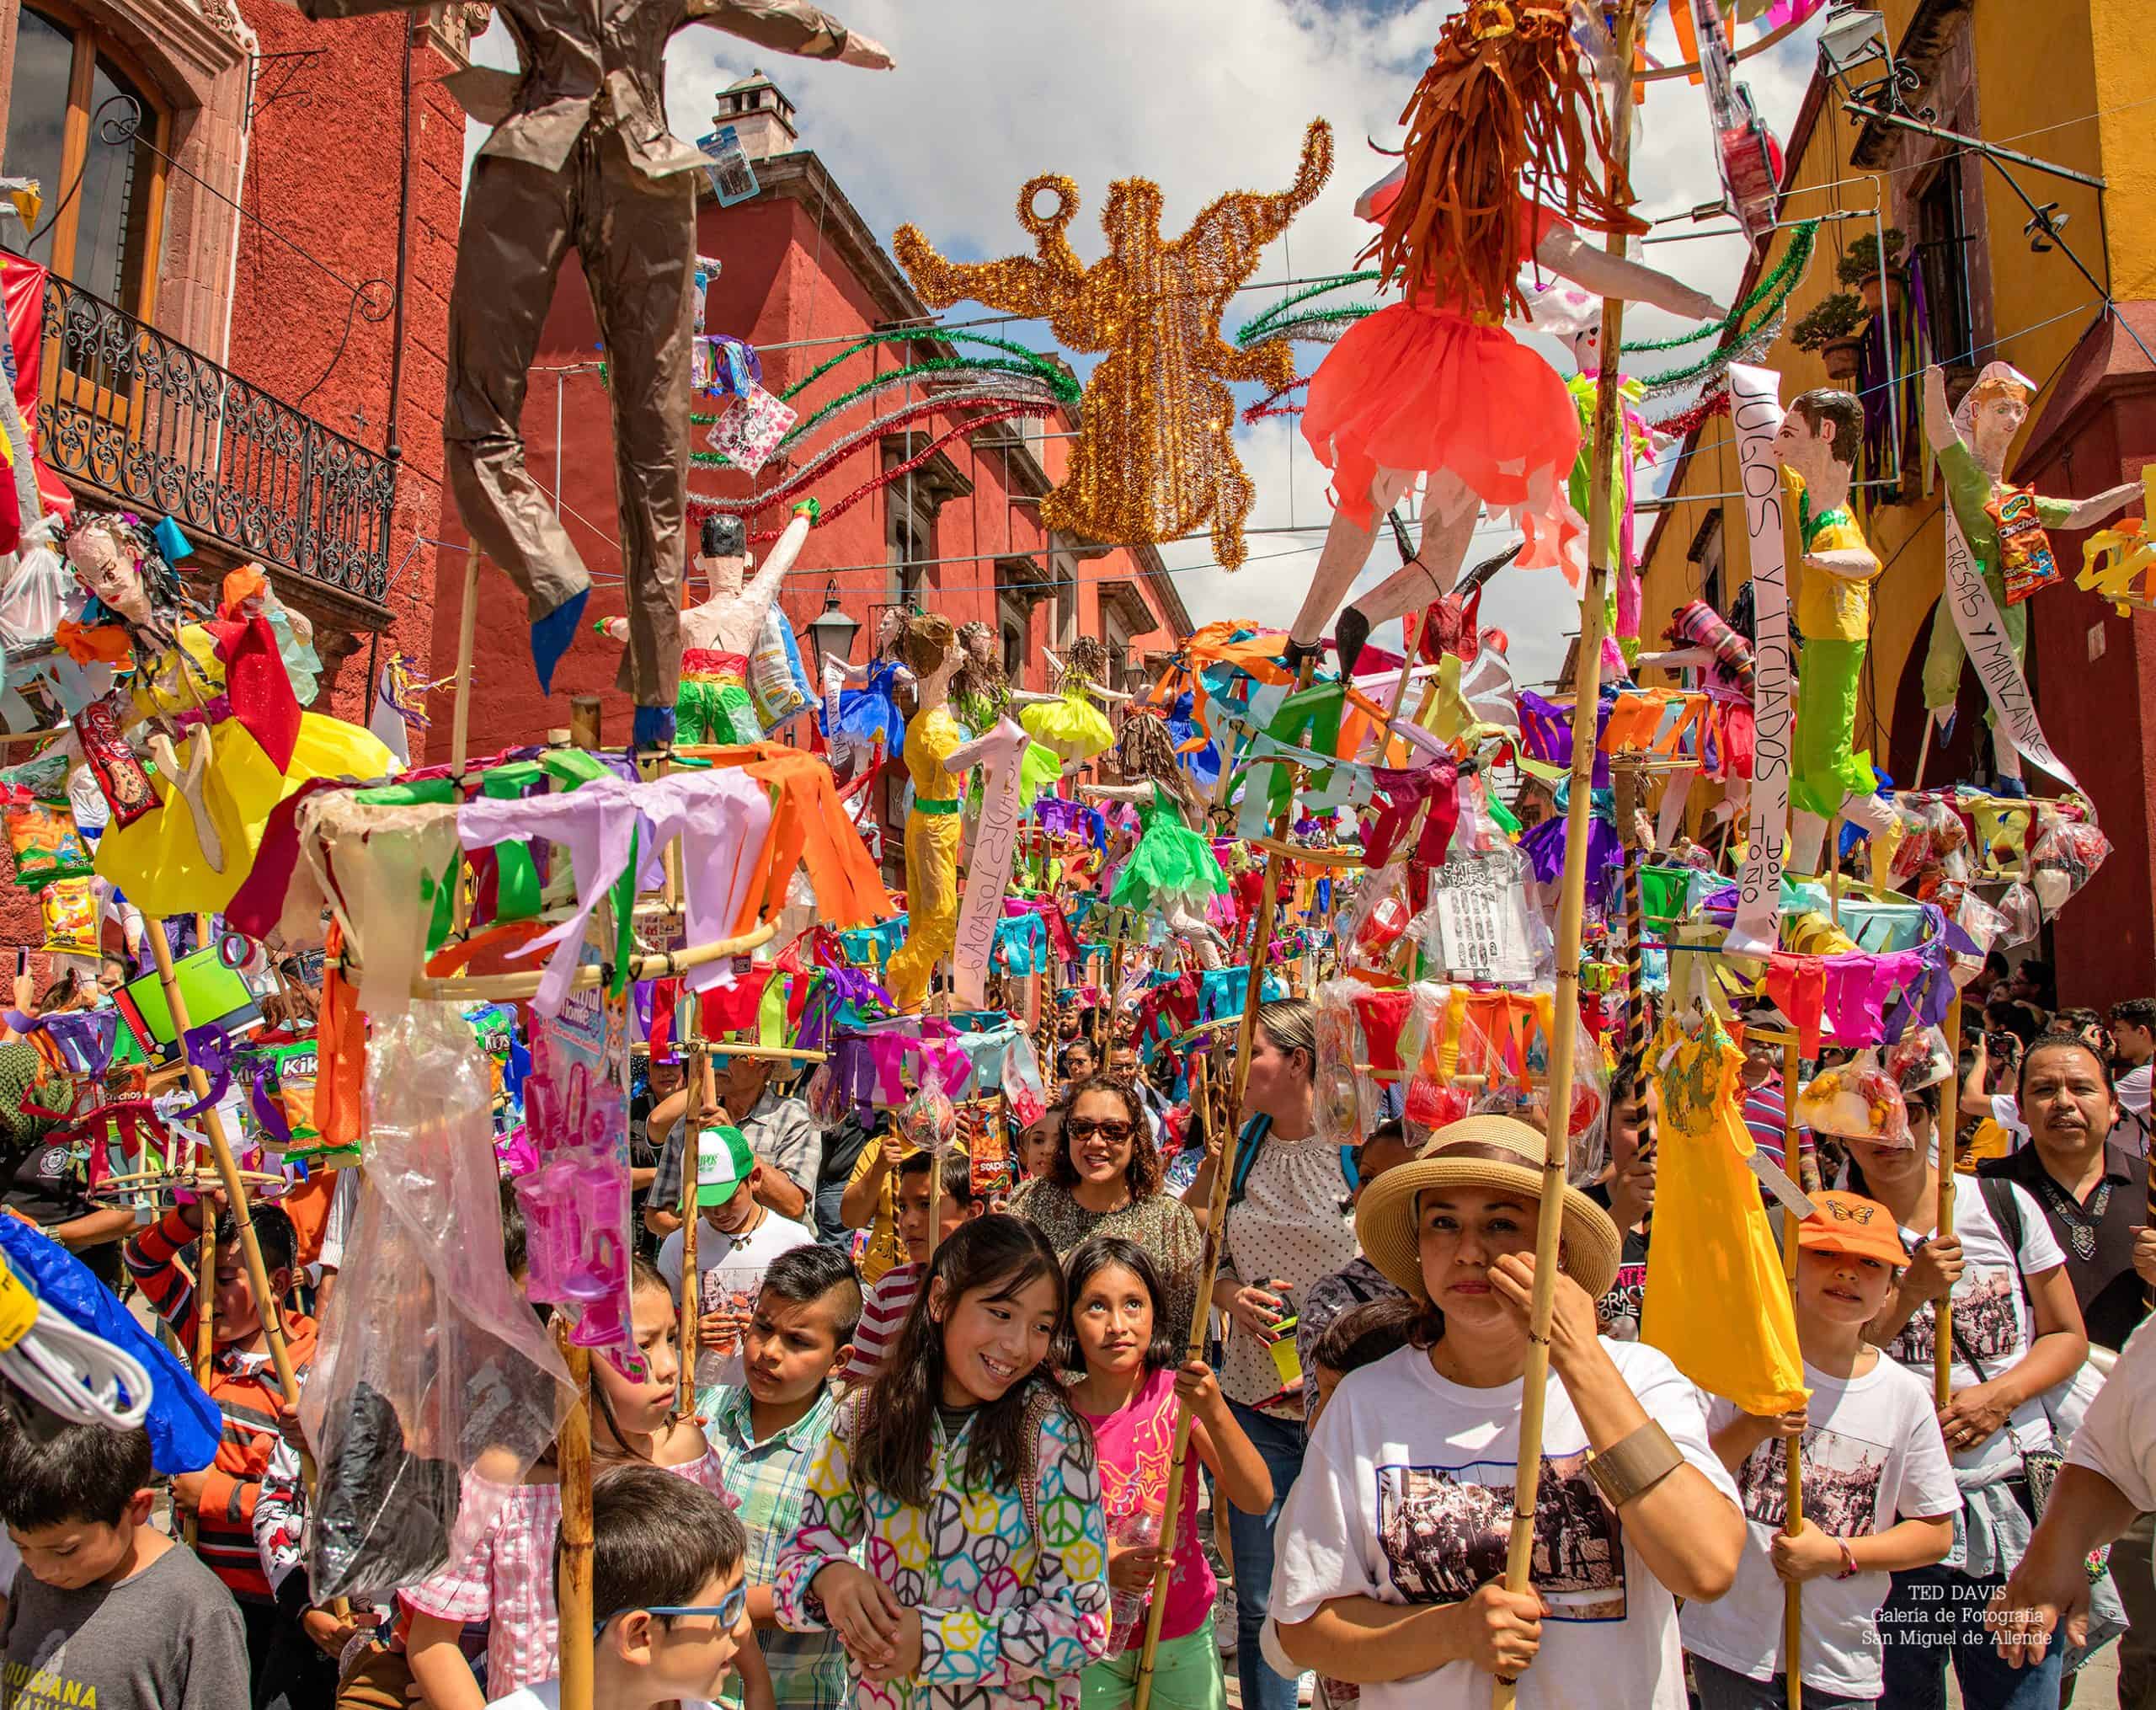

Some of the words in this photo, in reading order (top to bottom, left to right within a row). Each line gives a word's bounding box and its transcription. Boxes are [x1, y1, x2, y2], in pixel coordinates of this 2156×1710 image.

[1732, 378, 1781, 537] JUGOS
[1753, 564, 1785, 587] Y
[1969, 622, 1998, 638] Y
[1755, 611, 1790, 782] LICUADOS
[1974, 641, 2048, 765] MANZANAS
[1444, 862, 1482, 877] SKATE
[1451, 873, 1489, 888] BOARD
[1742, 814, 1764, 904] TOÑO
